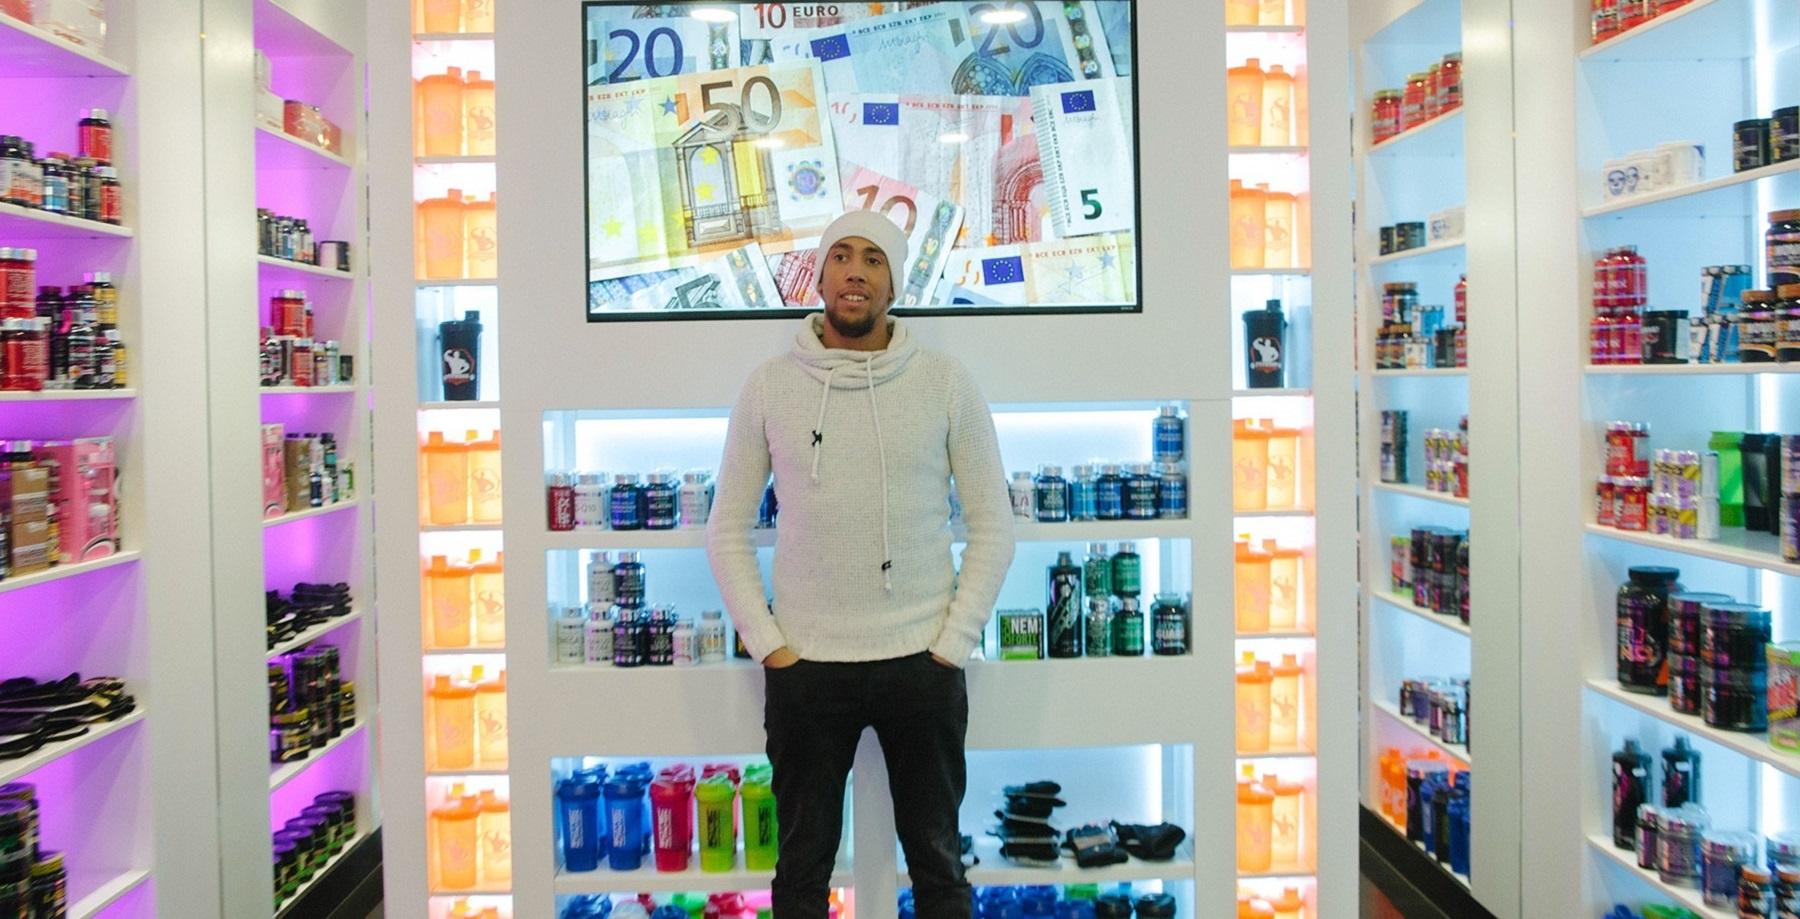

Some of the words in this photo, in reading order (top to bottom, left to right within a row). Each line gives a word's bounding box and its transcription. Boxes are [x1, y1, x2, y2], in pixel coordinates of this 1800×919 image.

[754, 3, 787, 29] 10
[793, 5, 839, 17] EURO
[609, 27, 684, 84] 20
[700, 76, 782, 138] 50
[1080, 188, 1103, 220] 5
